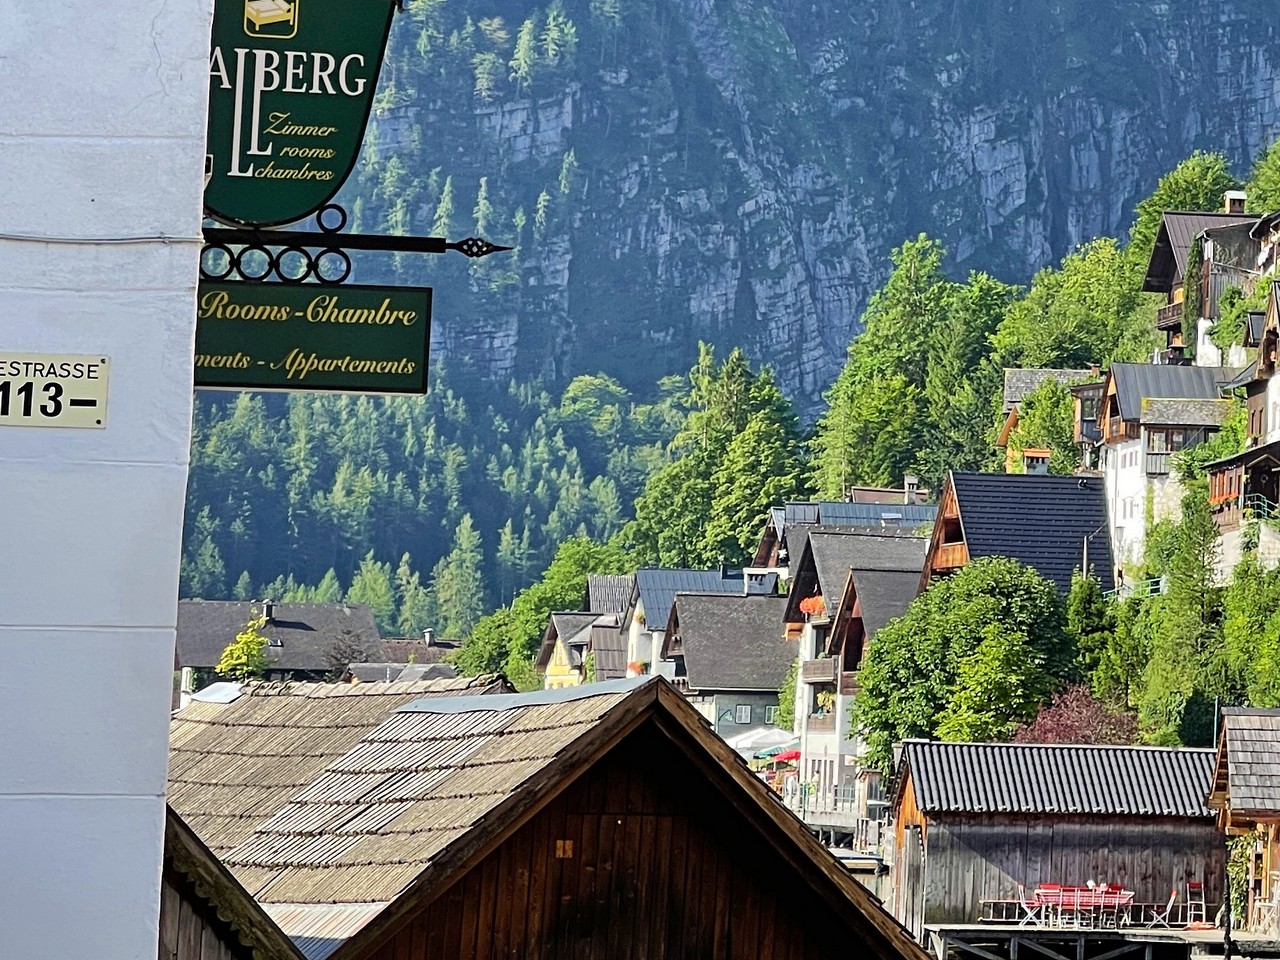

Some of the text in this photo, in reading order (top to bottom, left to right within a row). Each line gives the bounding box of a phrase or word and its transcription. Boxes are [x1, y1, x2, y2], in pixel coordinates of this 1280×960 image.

[263, 111, 338, 136] Zimmer
[279, 146, 336, 159] rooms
[254, 161, 335, 180] chambres
[0, 361, 100, 380] ESTRASSE
[270, 347, 417, 380] Appartements
